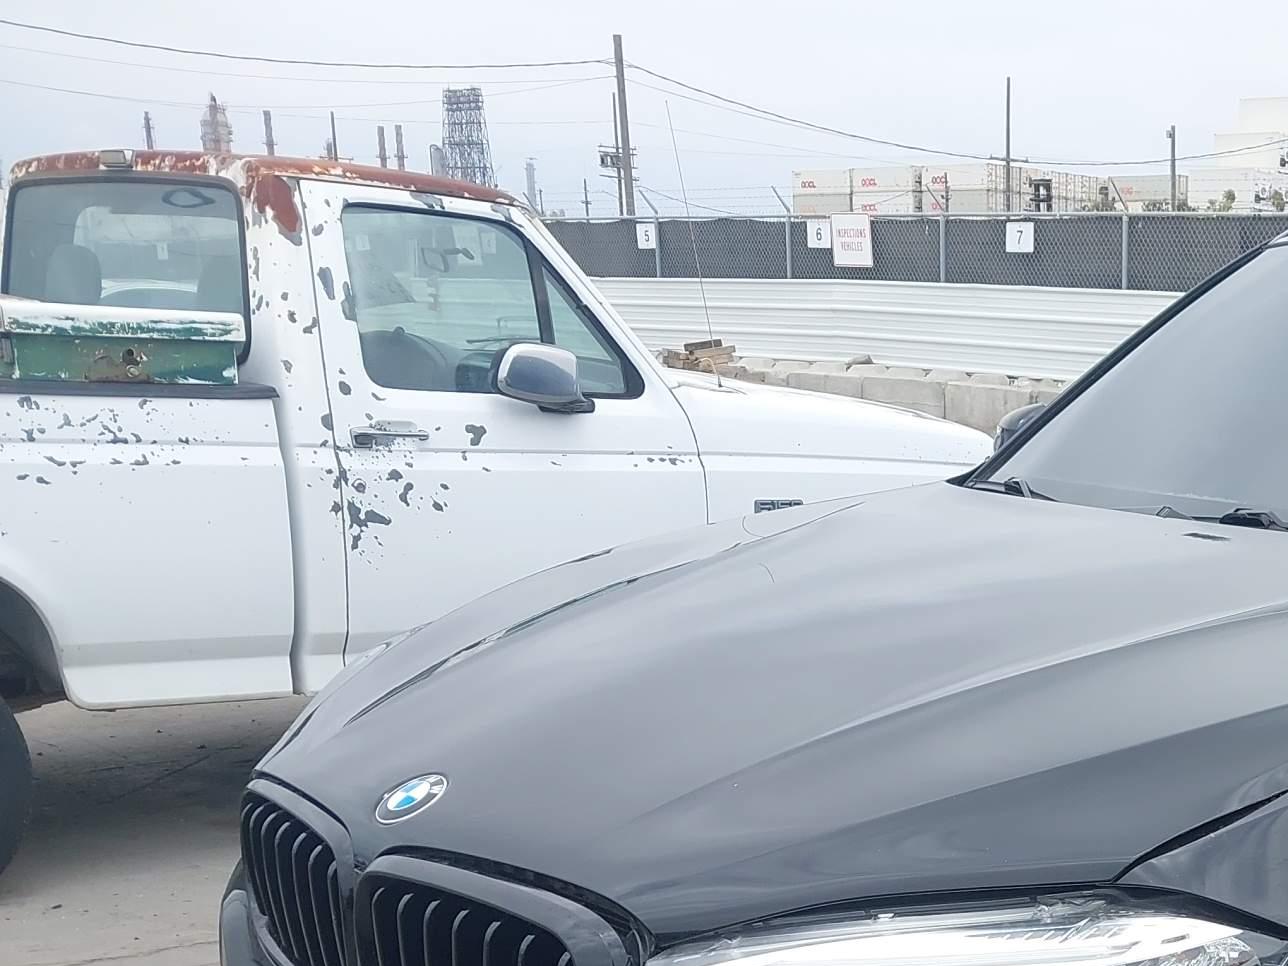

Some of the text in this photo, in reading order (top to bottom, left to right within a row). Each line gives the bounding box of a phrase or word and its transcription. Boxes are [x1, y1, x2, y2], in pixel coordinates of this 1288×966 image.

[931, 176, 947, 185] OOC
[644, 230, 650, 242] 5
[815, 227, 823, 241] 6
[1016, 230, 1024, 245] 7
